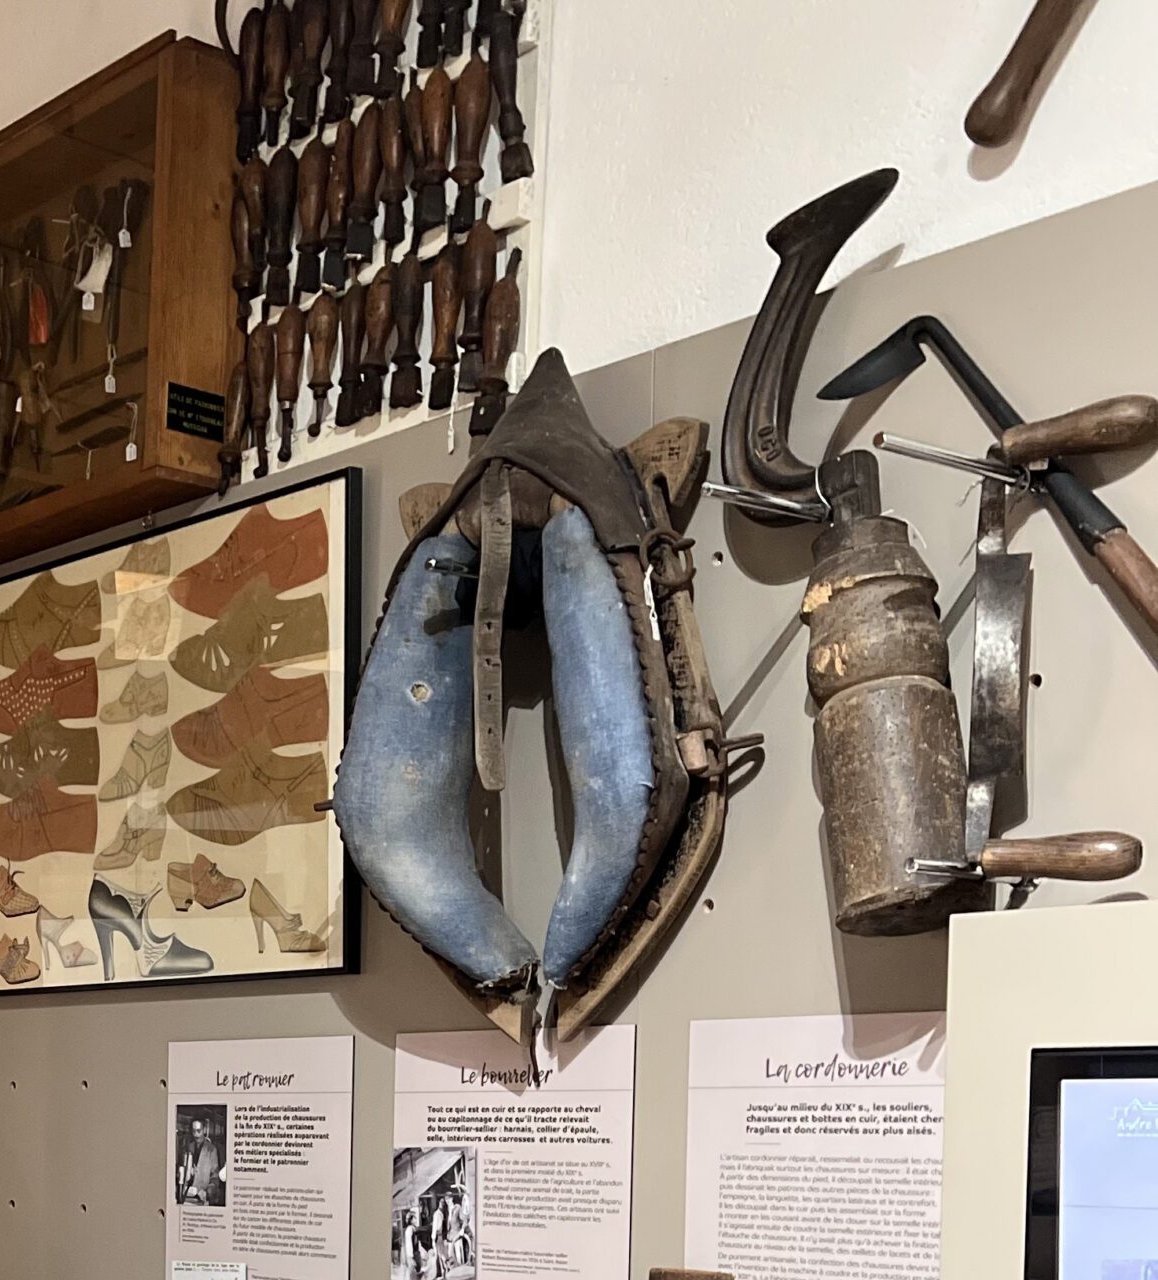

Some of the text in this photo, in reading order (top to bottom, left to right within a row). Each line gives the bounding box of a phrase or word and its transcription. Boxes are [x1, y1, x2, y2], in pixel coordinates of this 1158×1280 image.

[766, 1053, 910, 1083] La cordonnerie
[461, 1062, 553, 1087] Le bourreler
[216, 1070, 294, 1091] Le patronnier
[455, 1105, 466, 1114] qui
[528, 1106, 562, 1114] rapporte
[747, 1103, 787, 1113] Jusqu'au
[790, 1102, 818, 1111] milieu
[821, 1102, 833, 1111] du
[872, 1102, 886, 1111] les
[889, 1102, 933, 1113] souliers,
[448, 1115, 492, 1124] capitonnage
[515, 1115, 532, 1124] qu'il
[746, 1114, 797, 1123] chaussures
[812, 1114, 843, 1123] bottes
[859, 1114, 880, 1124] cuir,
[882, 1114, 918, 1123] étaient
[921, 1114, 944, 1123] cher
[438, 1124, 499, 1132] bourrelier-sellier
[504, 1125, 534, 1134] harnais,
[562, 1125, 600, 1135] d'épaule,
[746, 1125, 780, 1136] fragiles
[794, 1125, 817, 1134] donc
[819, 1125, 860, 1134] réservés
[883, 1126, 904, 1136] plus
[906, 1126, 936, 1135] aisés.
[234, 1131, 266, 1139] opérations
[426, 1134, 445, 1143] selle,
[447, 1134, 482, 1142] intérieurs
[269, 1149, 302, 1158] spécialisés
[278, 1158, 309, 1167] patronnier
